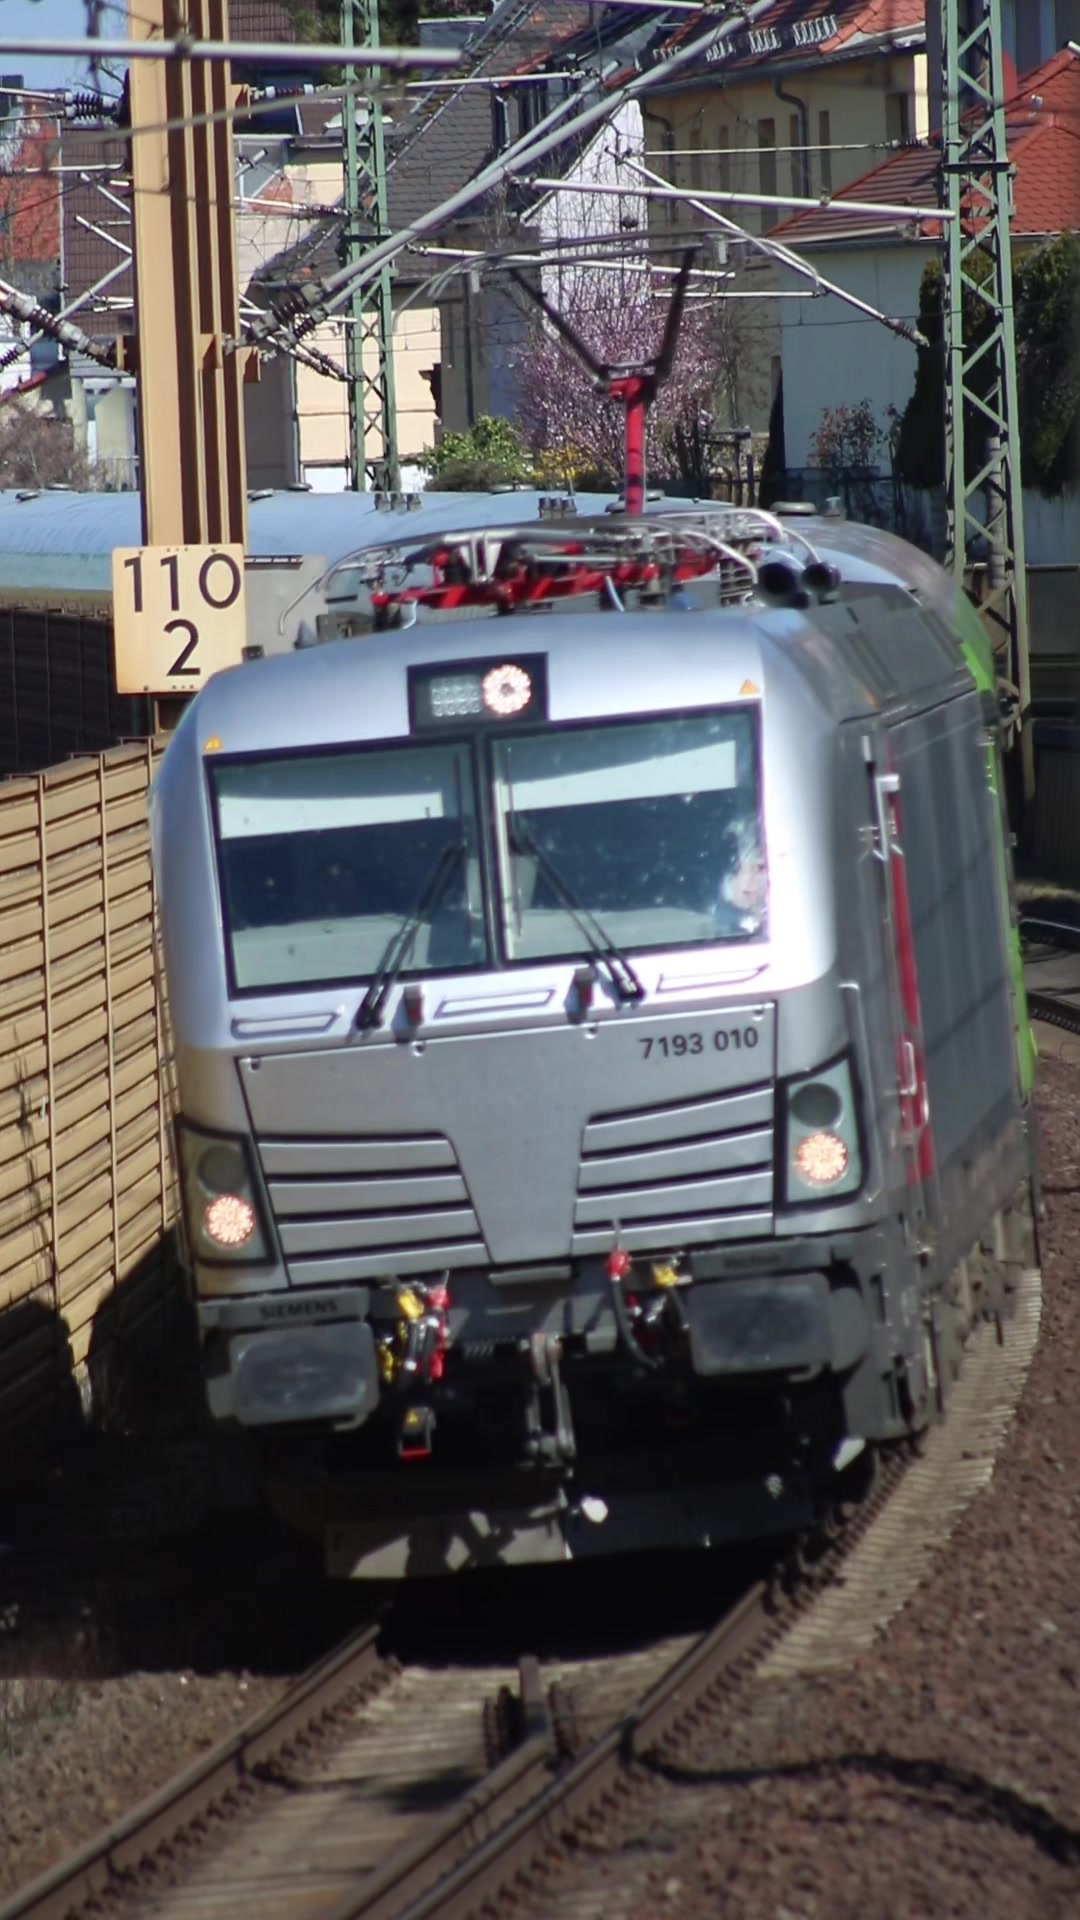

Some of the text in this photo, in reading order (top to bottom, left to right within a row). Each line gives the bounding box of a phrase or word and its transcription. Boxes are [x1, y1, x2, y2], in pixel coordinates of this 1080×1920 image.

[124, 553, 241, 612] 110
[163, 619, 201, 676] 2
[639, 1027, 759, 1060] 7193 010
[259, 1300, 338, 1319] SIEMENS
